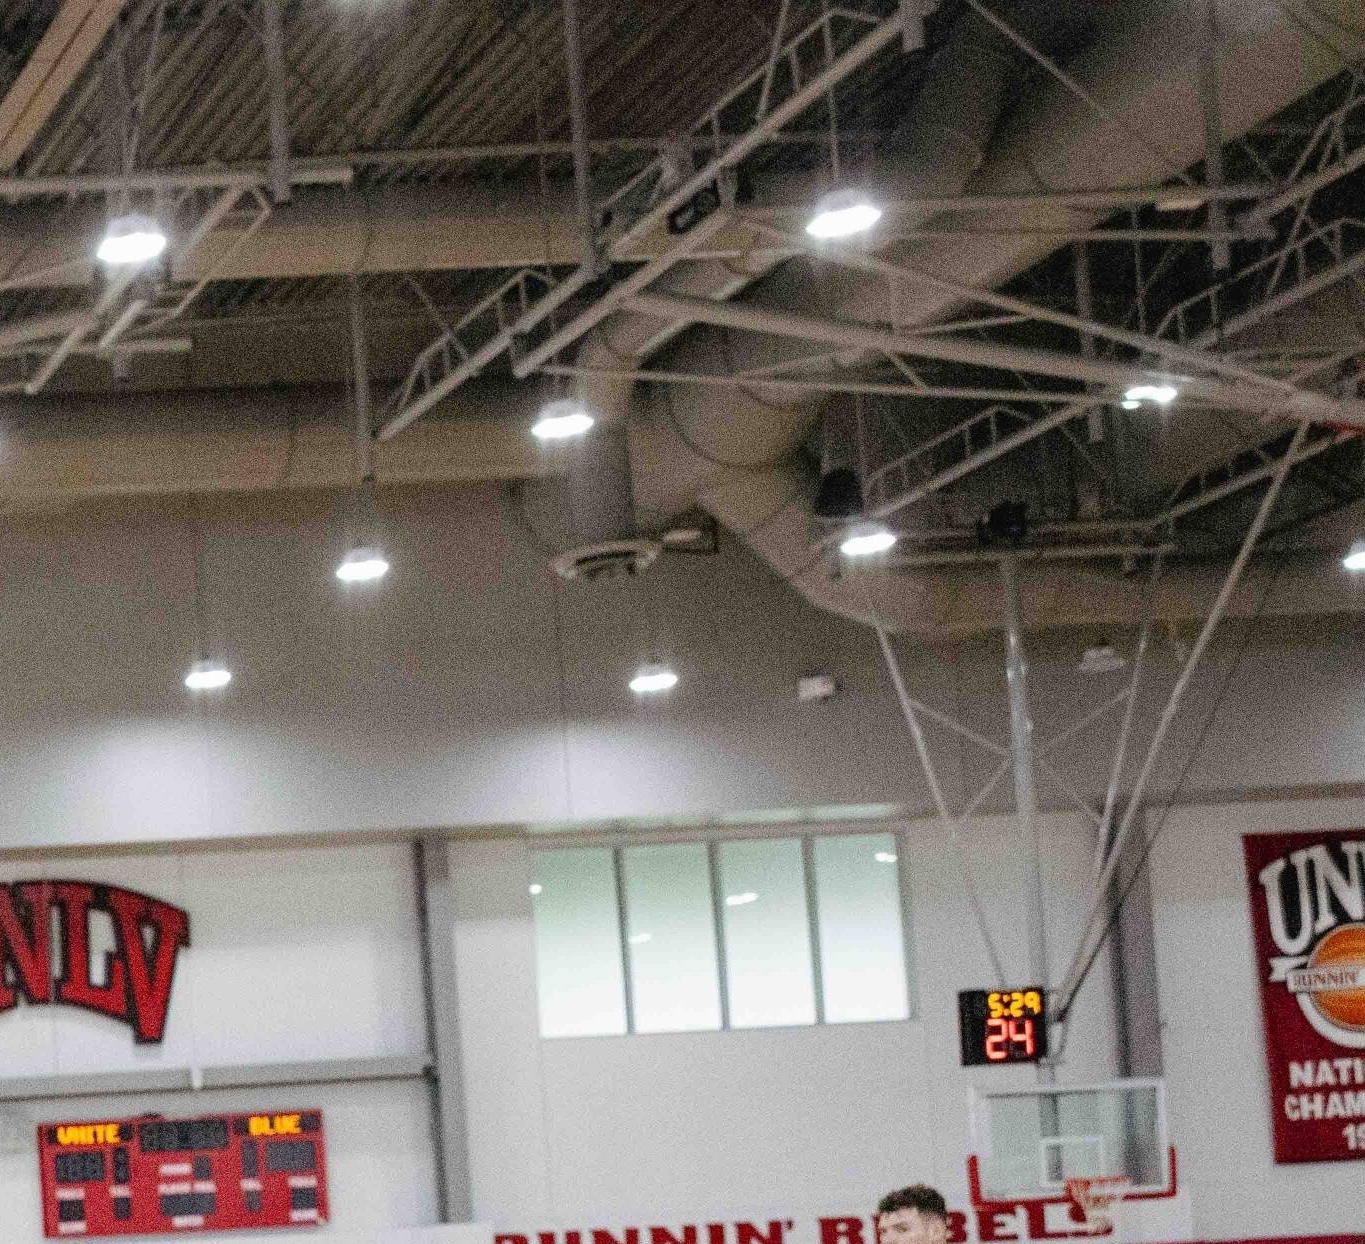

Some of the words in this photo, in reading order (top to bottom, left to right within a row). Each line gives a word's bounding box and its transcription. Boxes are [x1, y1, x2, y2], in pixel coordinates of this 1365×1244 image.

[987, 991, 1041, 1018] 5:29
[985, 1018, 1034, 1060] 24
[57, 1123, 119, 1146] WHITE
[249, 1114, 302, 1137] BLUE
